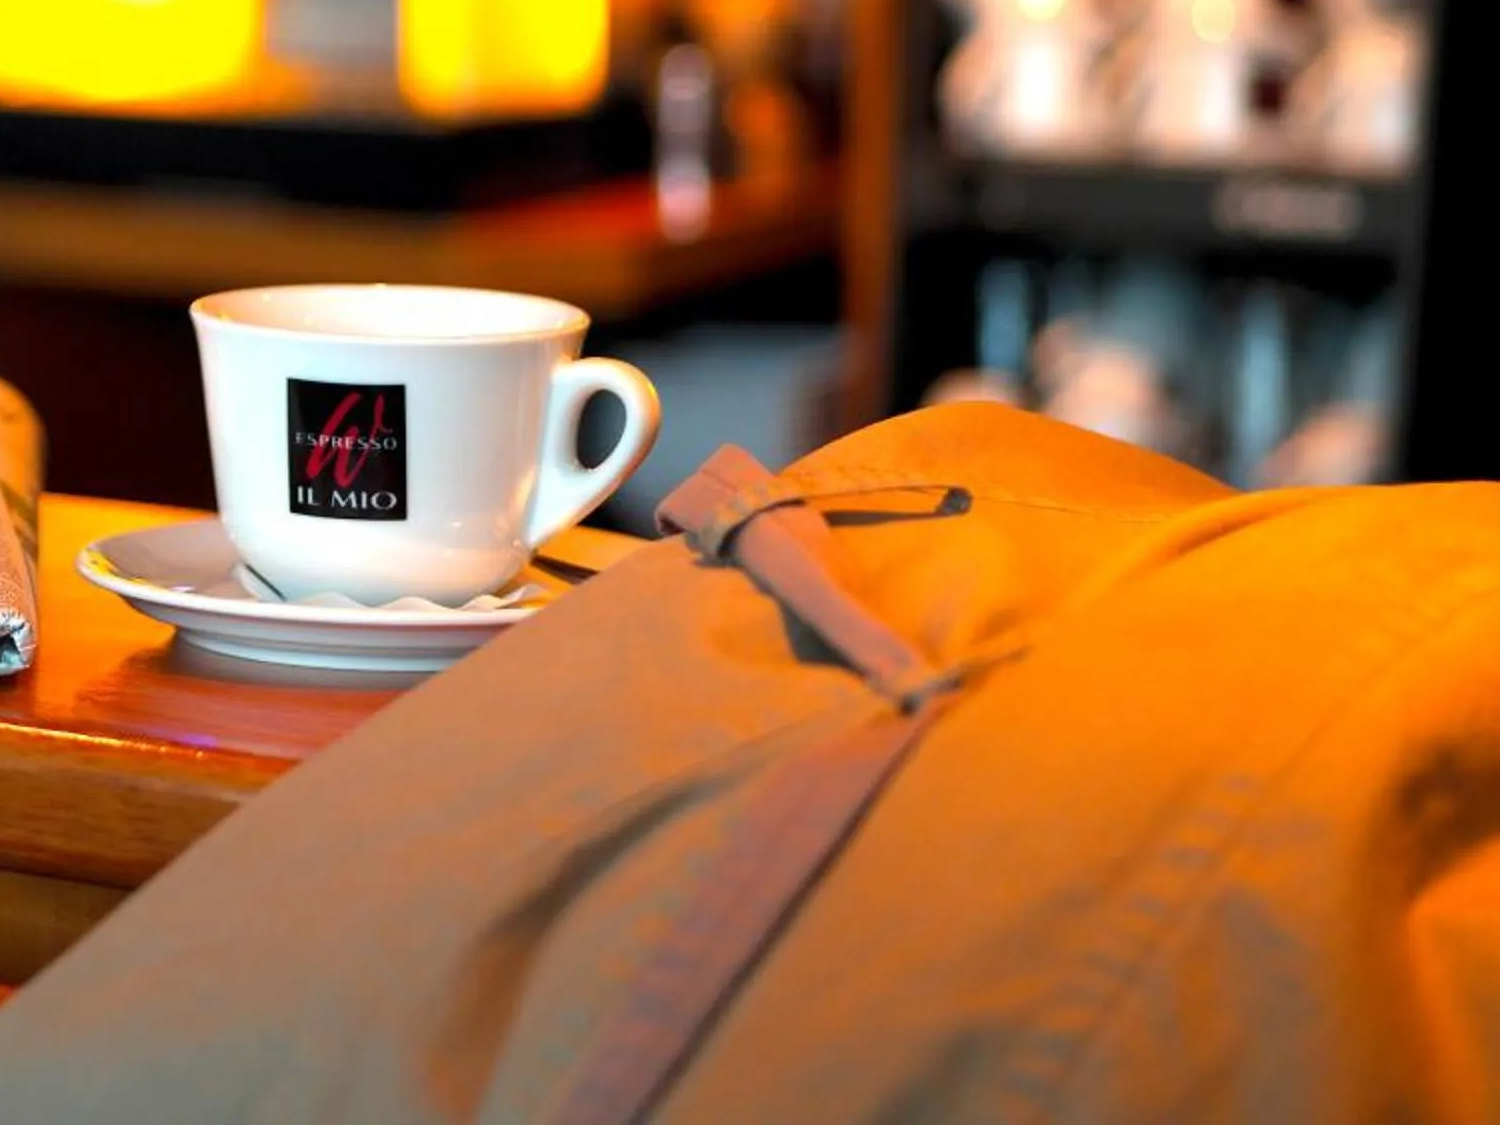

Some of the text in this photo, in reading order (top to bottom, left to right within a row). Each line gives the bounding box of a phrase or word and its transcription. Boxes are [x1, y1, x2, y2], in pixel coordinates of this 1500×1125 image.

[295, 431, 398, 451] ESPRESSO
[297, 485, 398, 510] IL MIO
